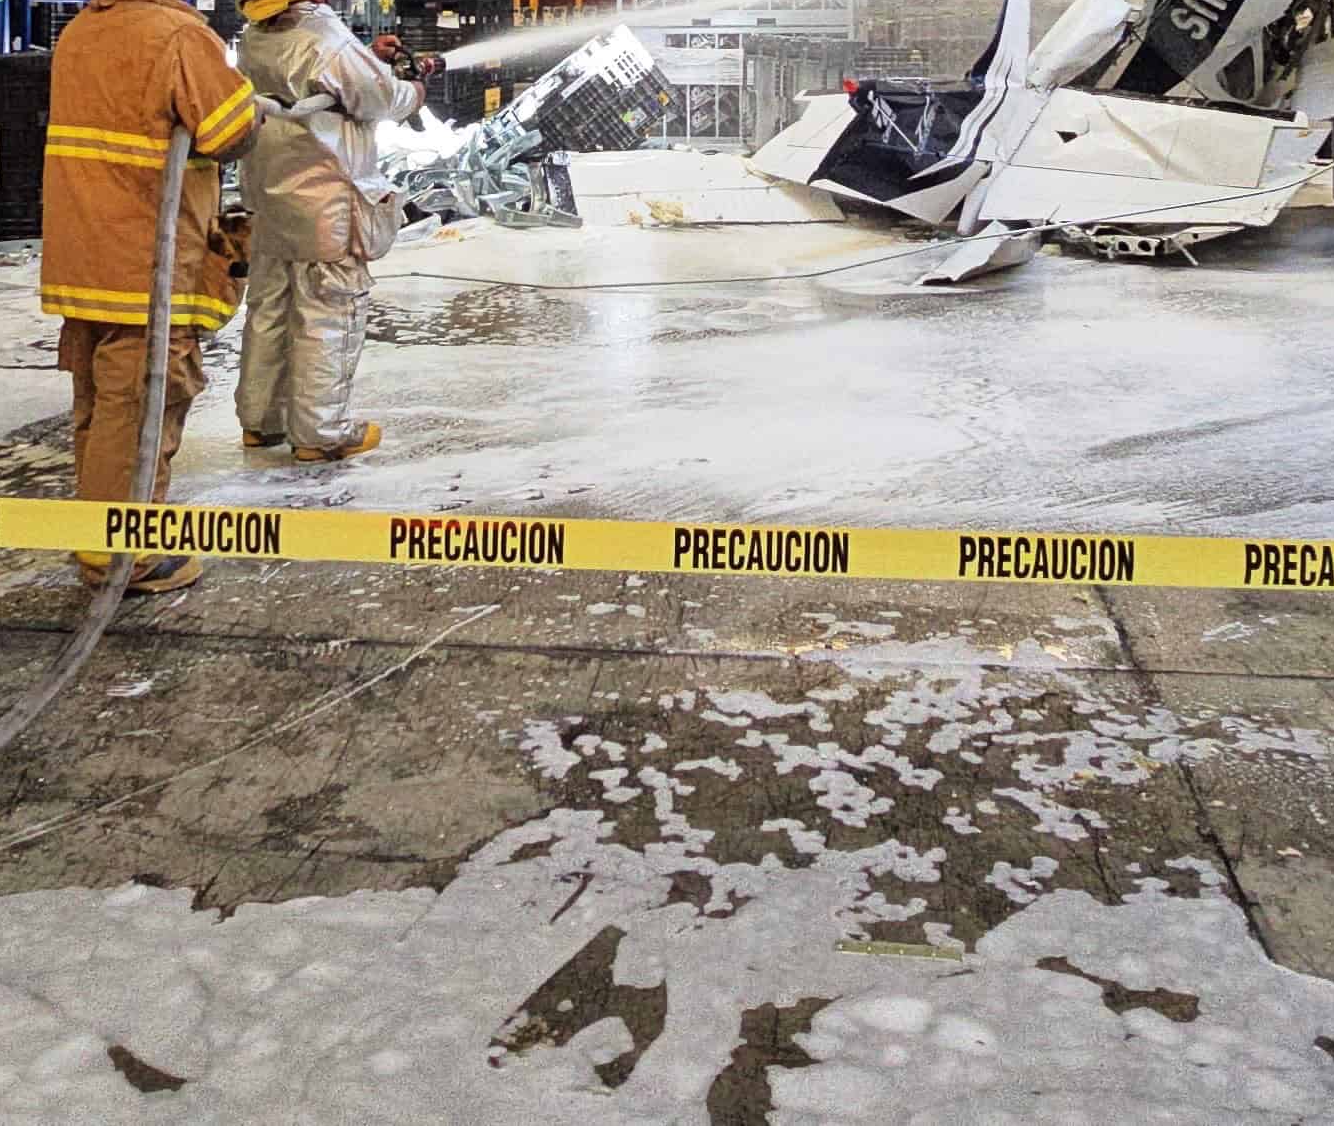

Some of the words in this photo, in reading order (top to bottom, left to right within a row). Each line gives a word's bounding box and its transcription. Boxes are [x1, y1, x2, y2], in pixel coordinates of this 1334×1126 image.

[107, 508, 280, 555] PRECAUCION
[391, 519, 564, 564] PRECAUCION
[674, 528, 848, 573] PRECAUCION
[959, 536, 1134, 581] PRECAUCION
